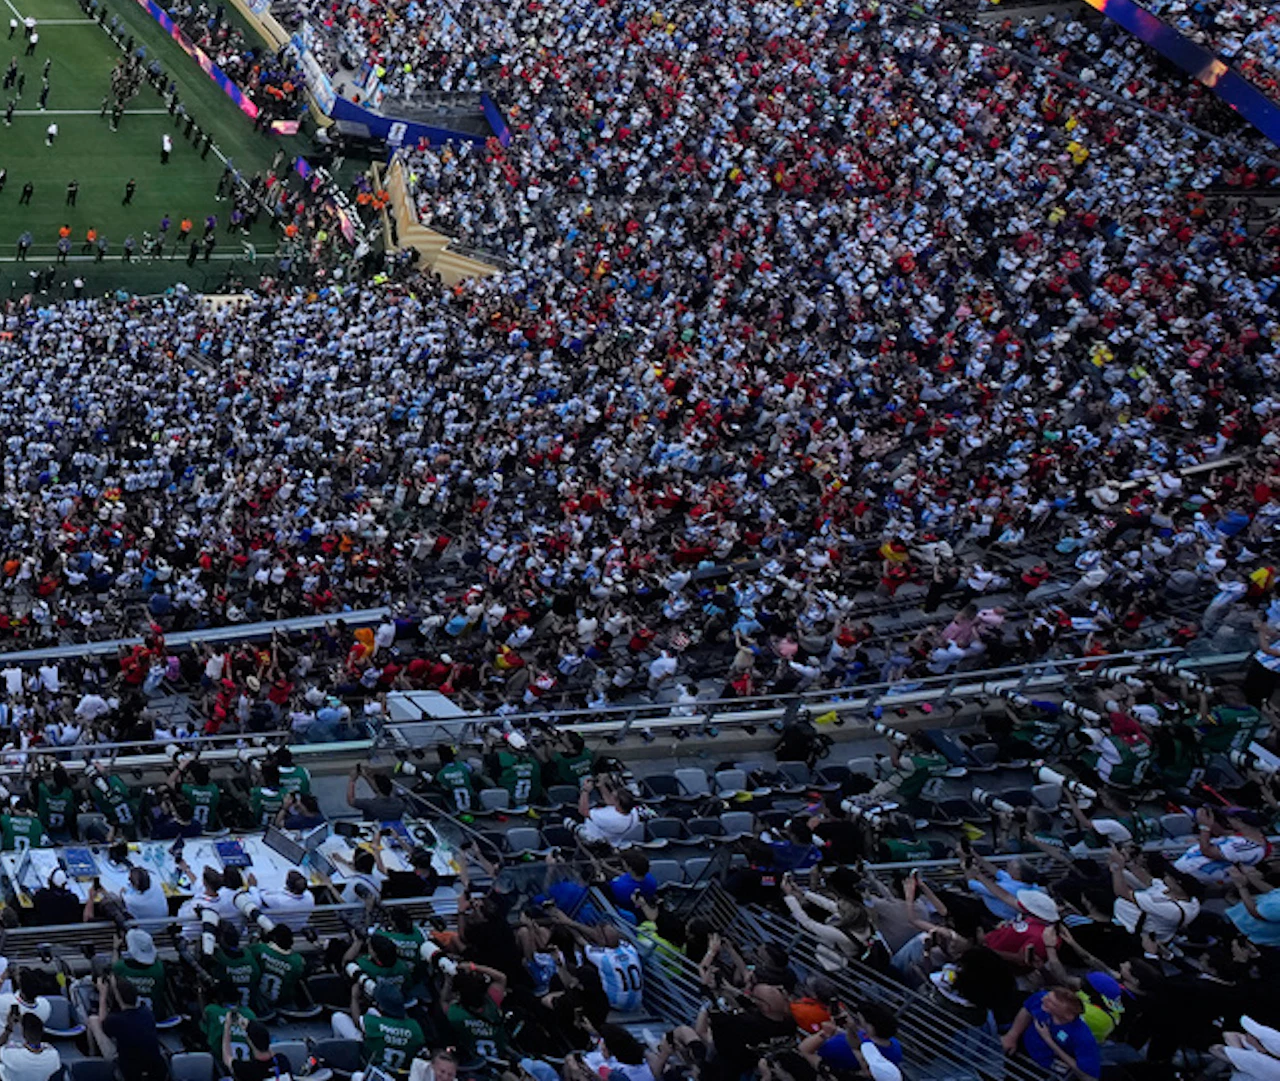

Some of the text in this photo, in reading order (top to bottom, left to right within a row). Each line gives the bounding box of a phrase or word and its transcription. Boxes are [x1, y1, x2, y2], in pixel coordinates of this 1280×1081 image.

[226, 965, 252, 975] PHOTO
[261, 952, 292, 971] PHOTO
[615, 964, 640, 992] 10
[379, 1024, 412, 1039] PHOTO
